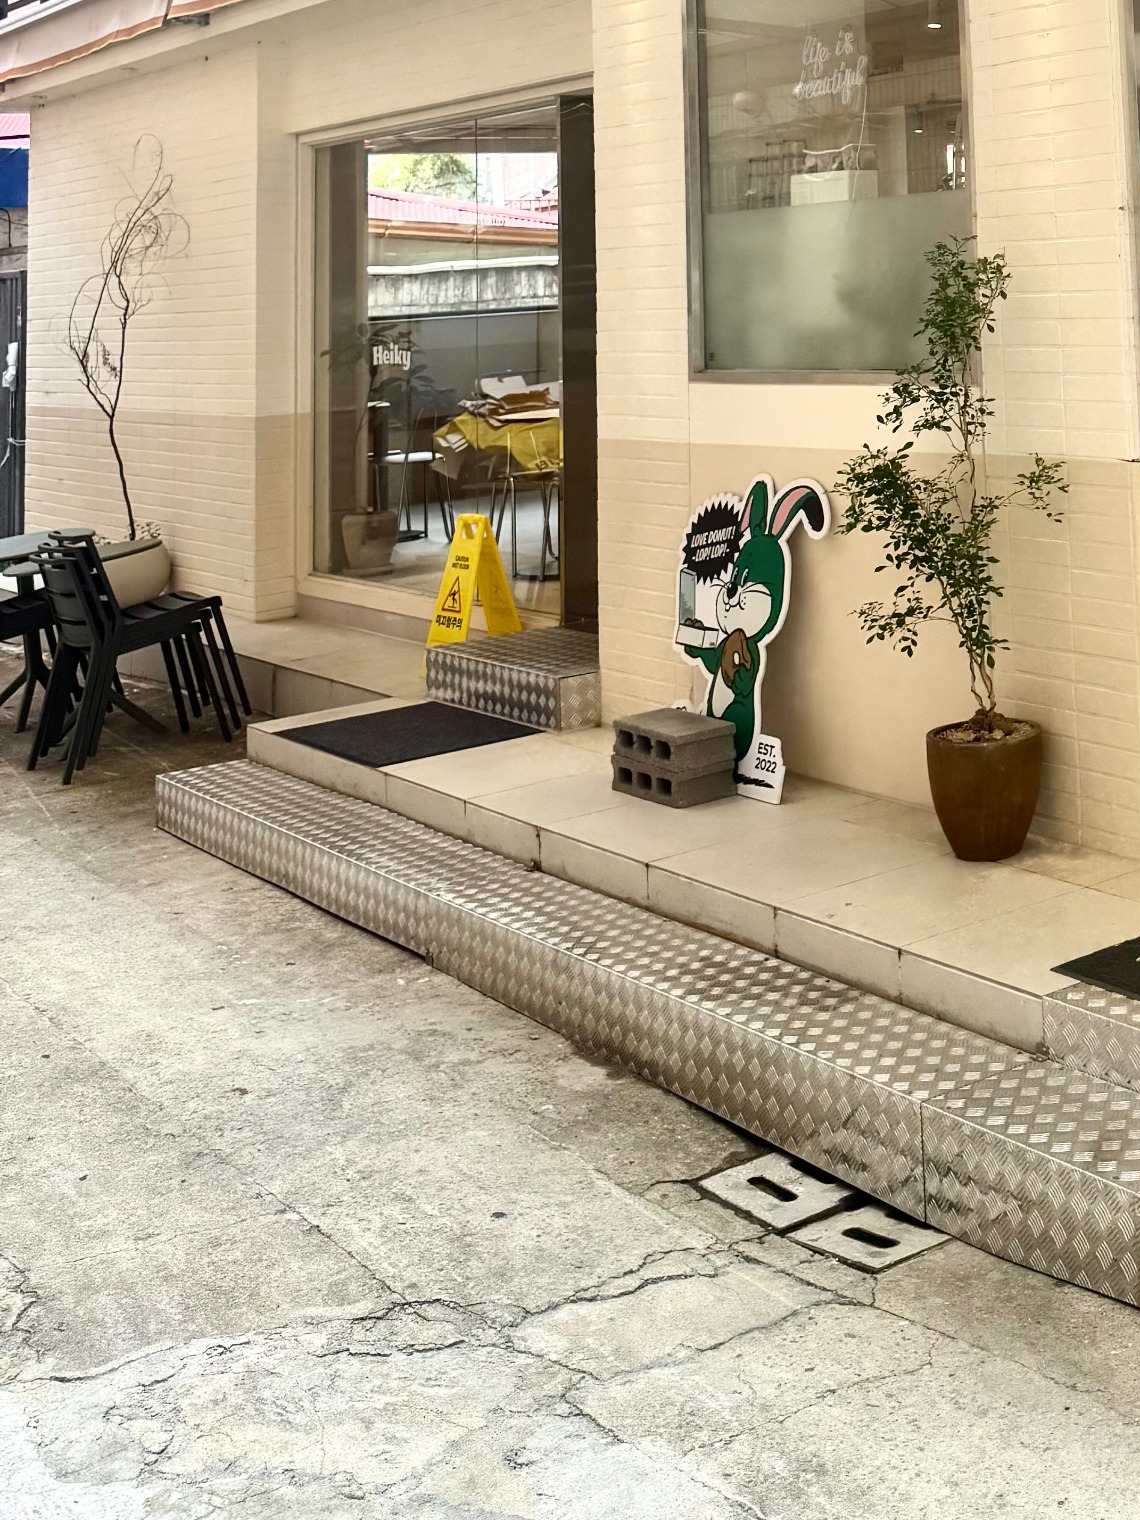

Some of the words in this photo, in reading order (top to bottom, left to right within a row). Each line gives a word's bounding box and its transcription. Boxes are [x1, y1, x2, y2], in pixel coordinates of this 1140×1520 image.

[372, 341, 412, 371] Heiky
[691, 531, 709, 548] LOVE
[708, 525, 736, 544] DONUT!
[435, 614, 464, 631] 미끄럼주의
[757, 741, 776, 758] EST.
[754, 756, 777, 774] 2022
